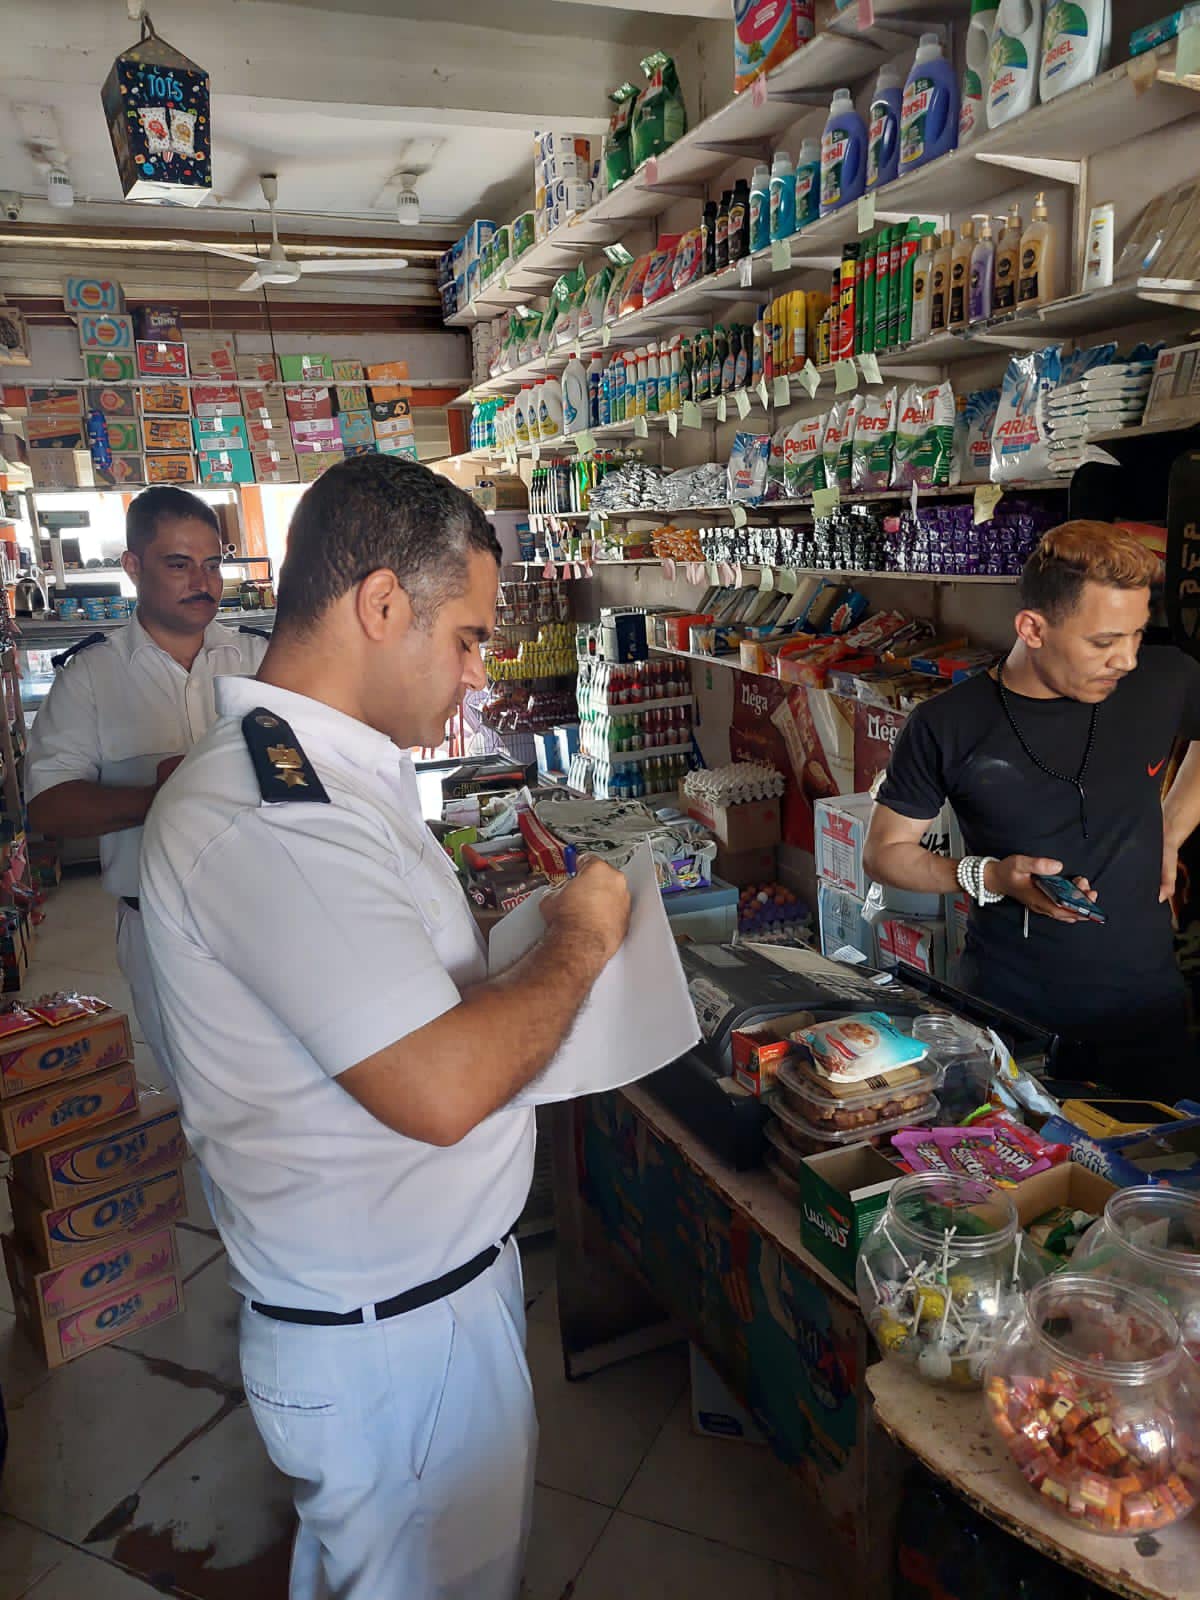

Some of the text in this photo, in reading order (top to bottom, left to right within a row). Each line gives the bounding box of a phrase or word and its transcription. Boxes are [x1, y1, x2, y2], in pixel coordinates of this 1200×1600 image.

[147, 73, 184, 102] TOTS
[857, 414, 888, 431] Pers
[998, 416, 1038, 436] ARIEL
[785, 436, 817, 455] Persil
[970, 440, 992, 452] ARI
[742, 684, 768, 716] Mega
[867, 713, 900, 752] Meg
